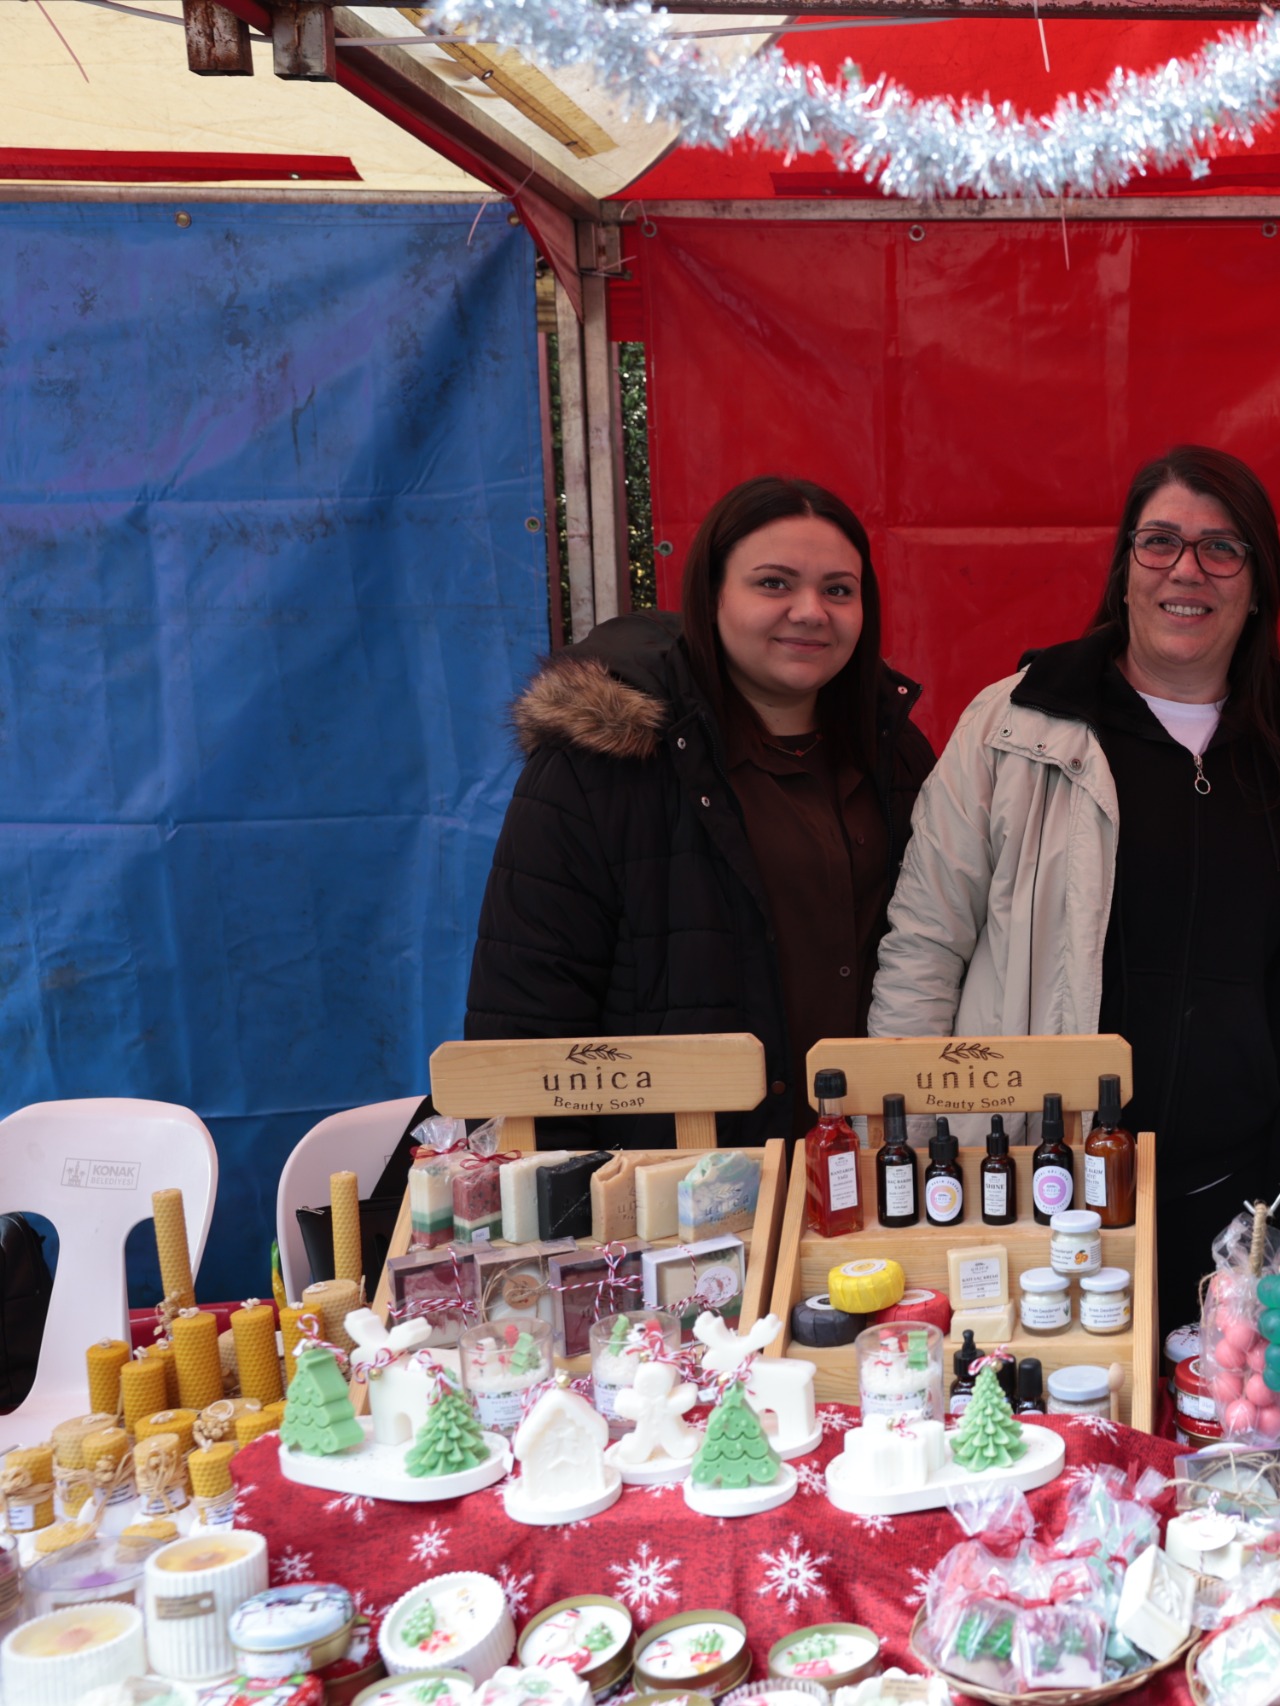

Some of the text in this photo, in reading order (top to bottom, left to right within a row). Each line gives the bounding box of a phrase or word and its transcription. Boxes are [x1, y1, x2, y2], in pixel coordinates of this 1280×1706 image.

[542, 1066, 652, 1091] unica
[917, 1065, 1023, 1090] unica
[553, 1096, 645, 1112] Beauty Soap
[926, 1094, 1016, 1111] Beauty Soap
[92, 1164, 135, 1178] KONAK
[985, 1183, 1005, 1191] SHINE
